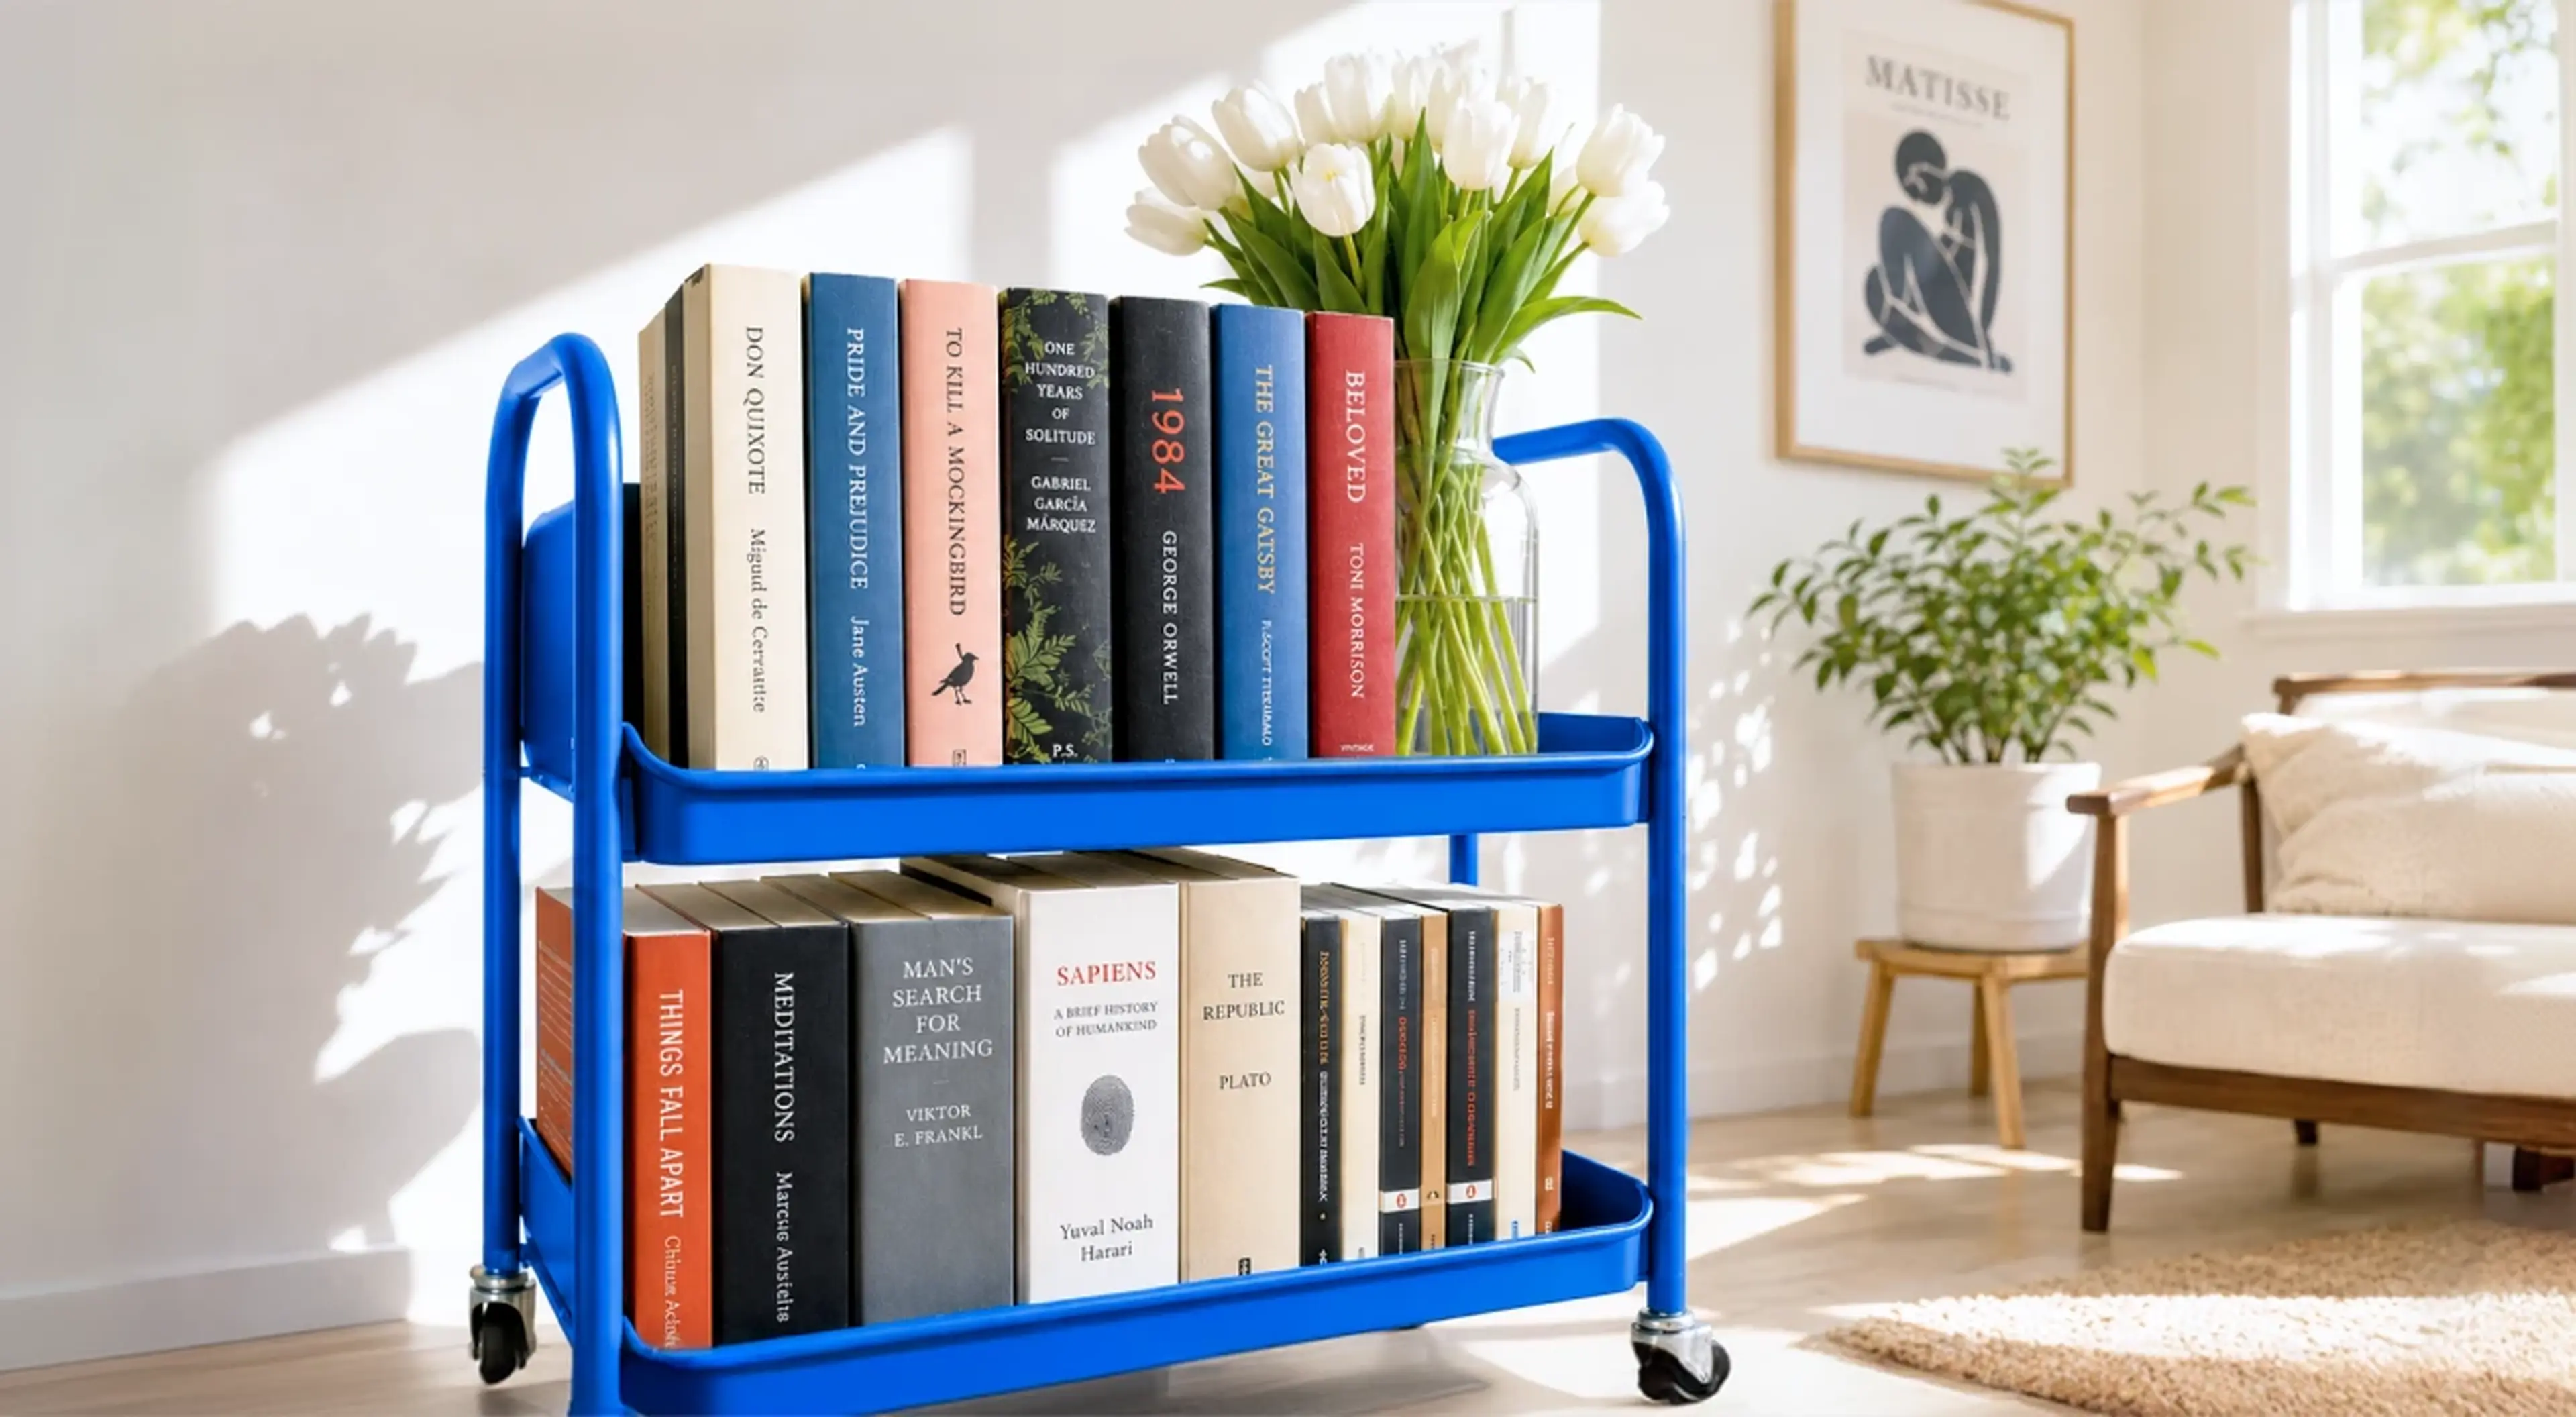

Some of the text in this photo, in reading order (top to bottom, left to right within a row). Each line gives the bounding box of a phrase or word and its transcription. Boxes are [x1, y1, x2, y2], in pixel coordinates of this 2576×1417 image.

[1866, 55, 2010, 120] MATISSE
[1044, 340, 1075, 355] ONE
[1025, 362, 1095, 379] HUNDRED
[1037, 384, 1082, 399] YEARS
[743, 327, 765, 494] DON QUIXOTE
[1052, 408, 1069, 419] OF
[1026, 429, 1095, 445] SOLITUDE
[1152, 388, 1185, 494] 1984
[1346, 370, 1365, 503] BELOVED
[847, 328, 867, 588] PRIDE AND PREJUDICE
[947, 328, 965, 615] TO KILL A MOCKINGBIRD
[1256, 365, 1275, 594] THE GREAT GATSBY
[1031, 476, 1091, 490] GABRIEL
[1027, 515, 1095, 533] MÁRQUEZ
[752, 598, 768, 619] de
[1163, 531, 1177, 704] GEORGE ORWELL
[1350, 543, 1364, 698] TONI MORRISON
[850, 615, 869, 727] Jane Austen
[1053, 743, 1078, 757] P.S.
[904, 957, 973, 978] MAN'S
[1058, 961, 1155, 986] SAPIENS
[1228, 972, 1263, 988] THE
[893, 984, 981, 1007] SEARCH
[1054, 1002, 1157, 1020] A BRIEF HISTORY
[1203, 1000, 1284, 1020] REPUBLIC
[917, 1014, 960, 1033] FOR
[1056, 1020, 1157, 1037] OF HUMANKIND
[775, 973, 794, 1142] MEDITATIONS
[884, 1039, 992, 1064] MEANING
[1220, 1072, 1271, 1090] PLATO
[660, 990, 683, 1217] THINGS FALL APART
[906, 1104, 971, 1122] VIKTOR
[895, 1125, 983, 1147] E. FRANKL
[1060, 1214, 1152, 1239] Yuval Noah
[1081, 1242, 1132, 1262] Harari
